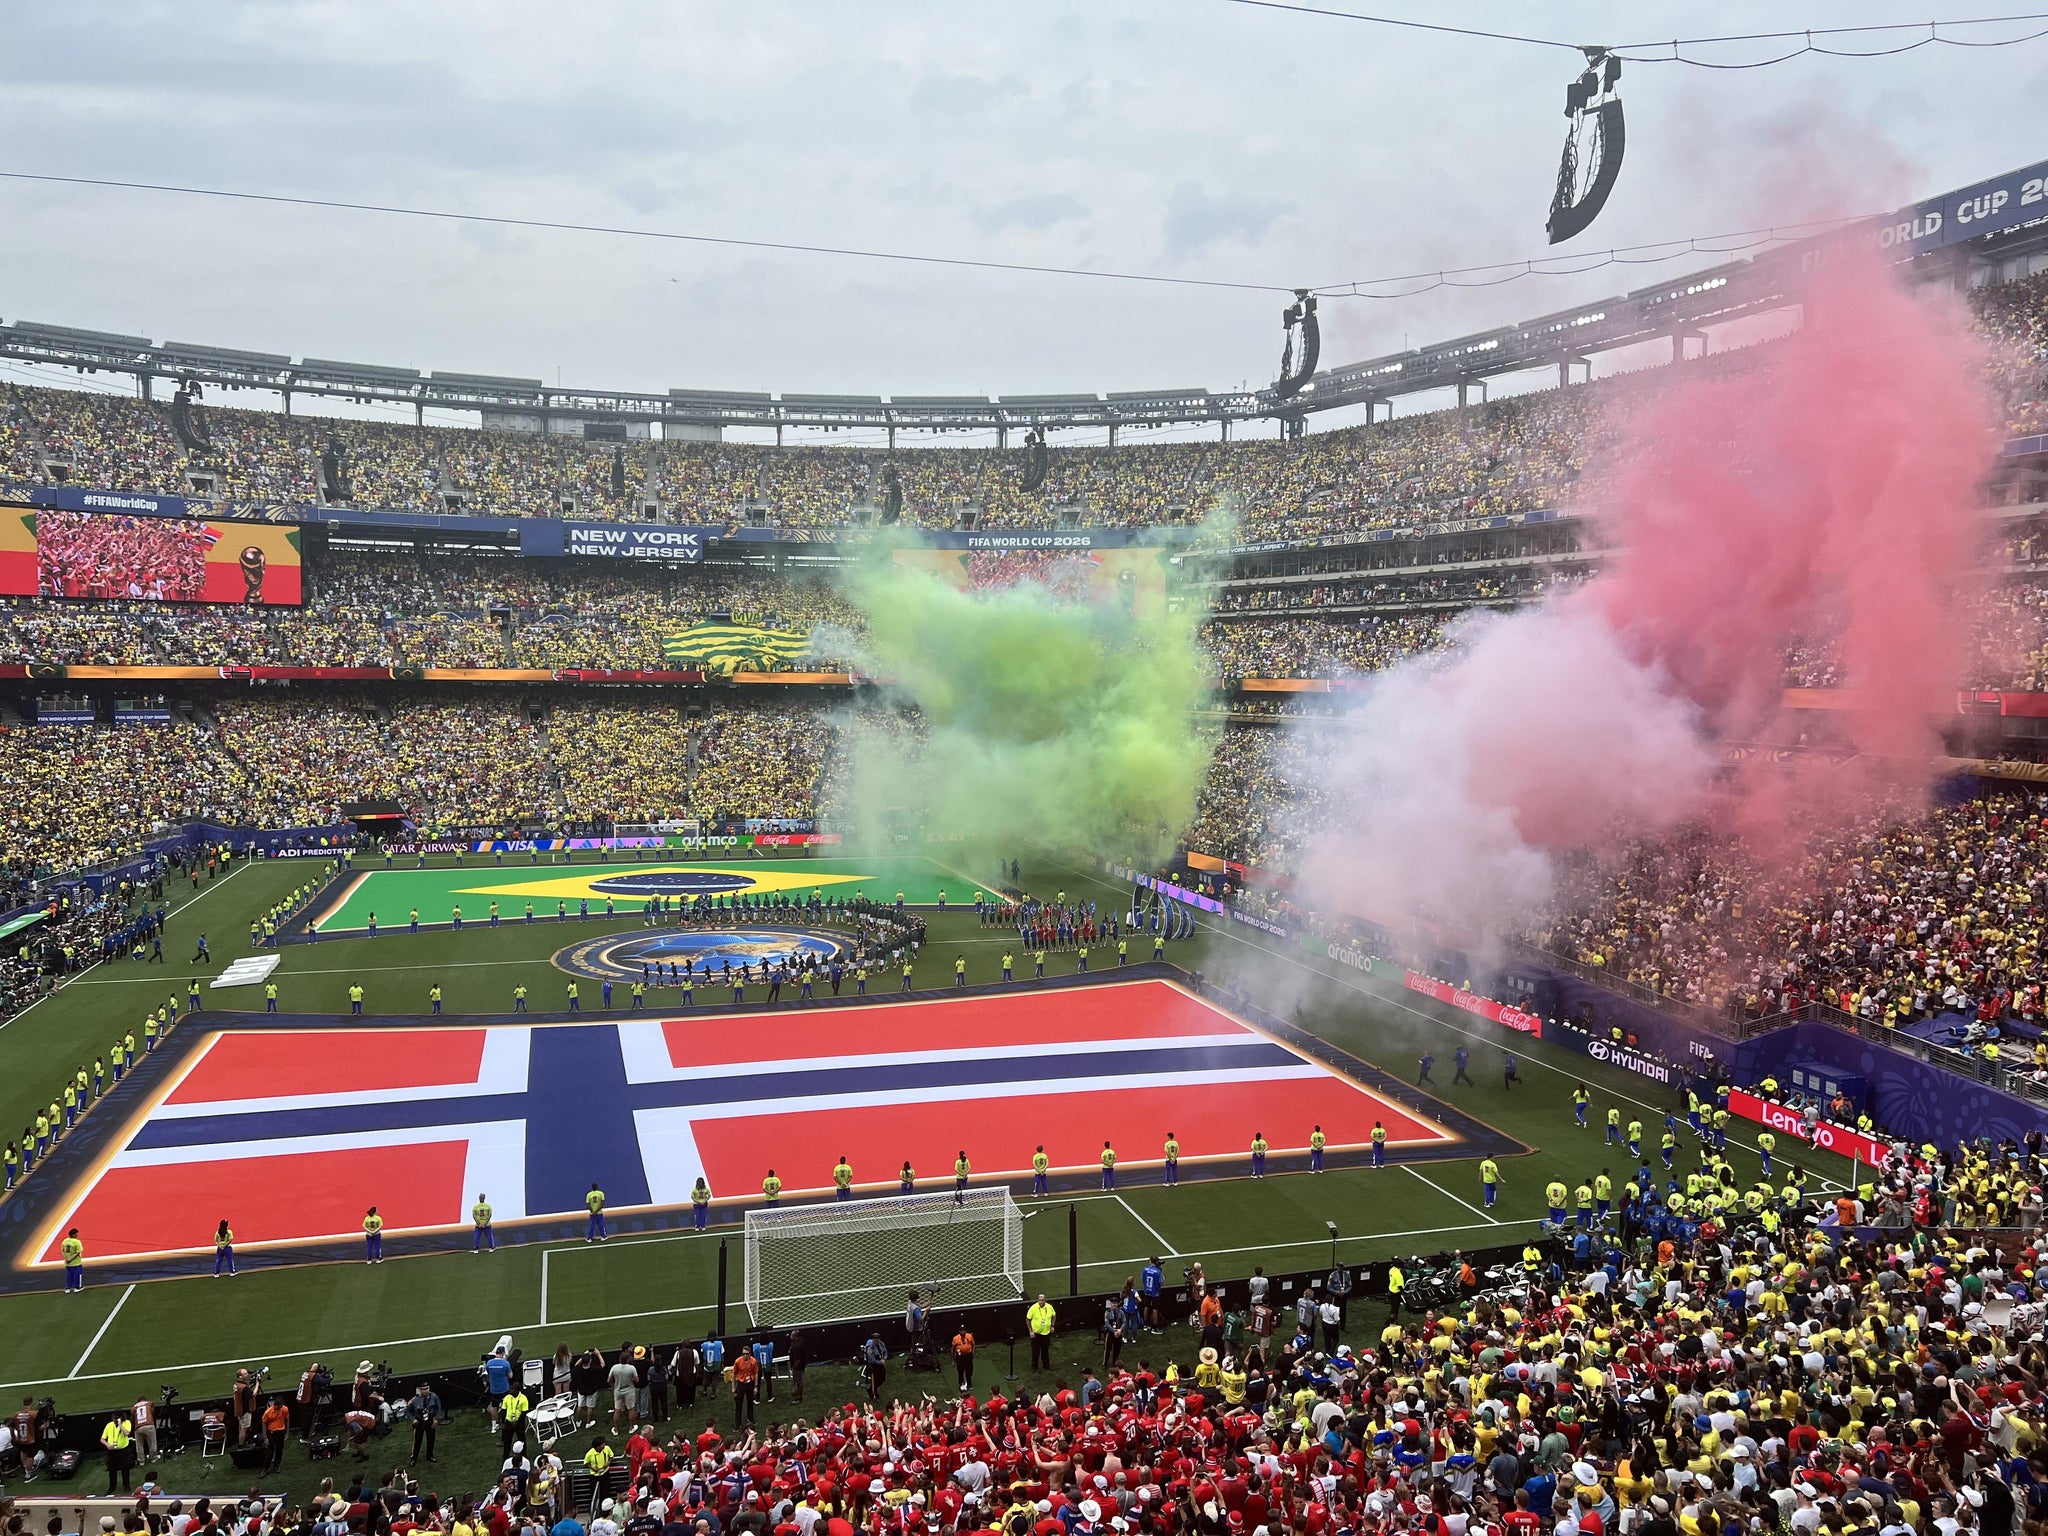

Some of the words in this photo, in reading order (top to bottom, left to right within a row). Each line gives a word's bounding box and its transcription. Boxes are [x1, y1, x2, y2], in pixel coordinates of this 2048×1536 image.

[1957, 190, 2009, 224] CUP
[2021, 178, 2048, 206] 2
[83, 494, 158, 512] #FIFAWorldCup
[571, 529, 627, 543] NEW
[632, 531, 699, 546] YORK
[968, 537, 991, 546] FIFA
[991, 537, 1030, 546] WORLD
[1031, 537, 1053, 546] CUP
[1053, 536, 1091, 546] 2026
[571, 544, 617, 556] NEW
[621, 546, 699, 559] JERSEY
[1261, 542, 1286, 551] JERSEY
[506, 840, 535, 851] VISA
[682, 834, 738, 846] aramco
[763, 834, 791, 845] Coca-Cola
[277, 848, 301, 858] ADI
[381, 843, 416, 855] QATAR
[420, 842, 469, 853] AIRWAYS
[1136, 872, 1148, 888] VISA
[1233, 911, 1243, 922] FIFA
[1244, 914, 1260, 927] WORLD
[1260, 919, 1269, 931] CUP
[1269, 923, 1287, 938] 2026
[1327, 943, 1372, 972] aramco
[1411, 974, 1437, 998] Coca-Cola
[1453, 990, 1482, 1014] Coca-Cola
[1499, 1007, 1531, 1031] Coca-Cola
[1689, 1040, 1710, 1059] FIFA
[1611, 1050, 1669, 1083] HYUNDAI
